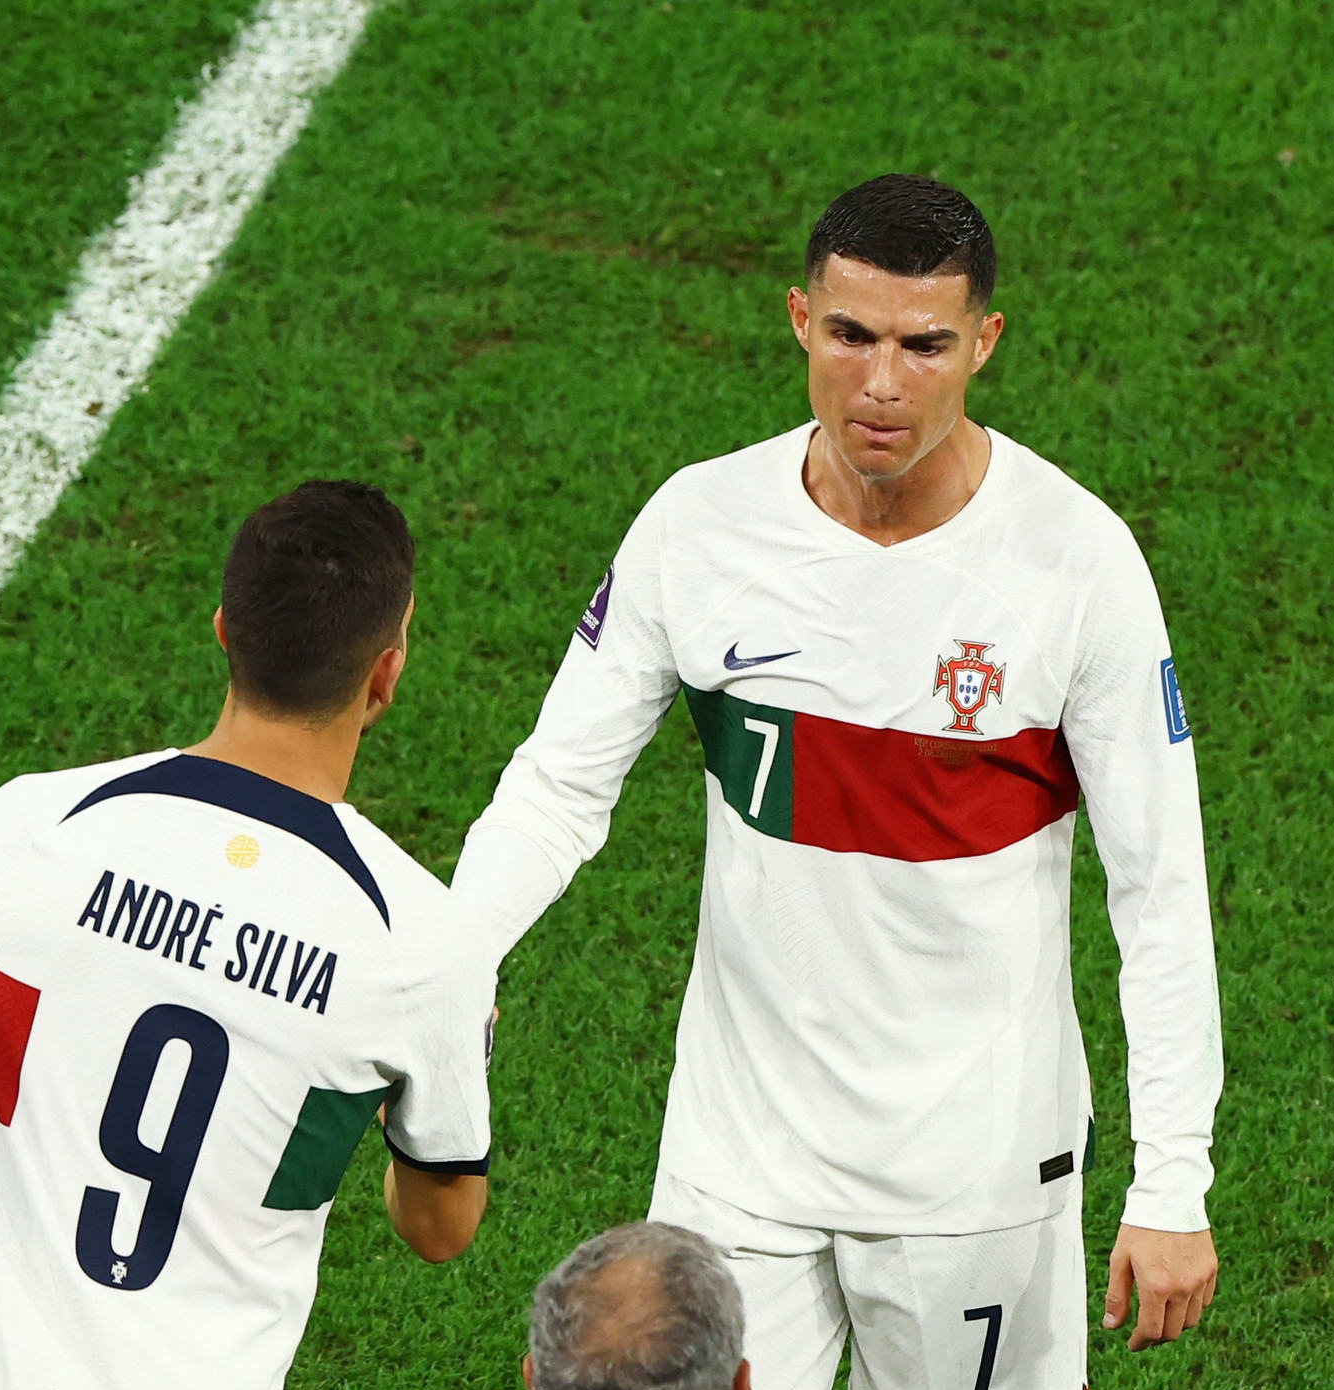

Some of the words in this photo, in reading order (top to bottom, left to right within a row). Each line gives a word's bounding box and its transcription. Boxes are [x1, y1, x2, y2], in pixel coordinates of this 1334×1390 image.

[744, 717, 779, 819] 7
[77, 870, 224, 971] ANDRÉ
[224, 924, 338, 1015] SILVA
[75, 1003, 230, 1291] 9
